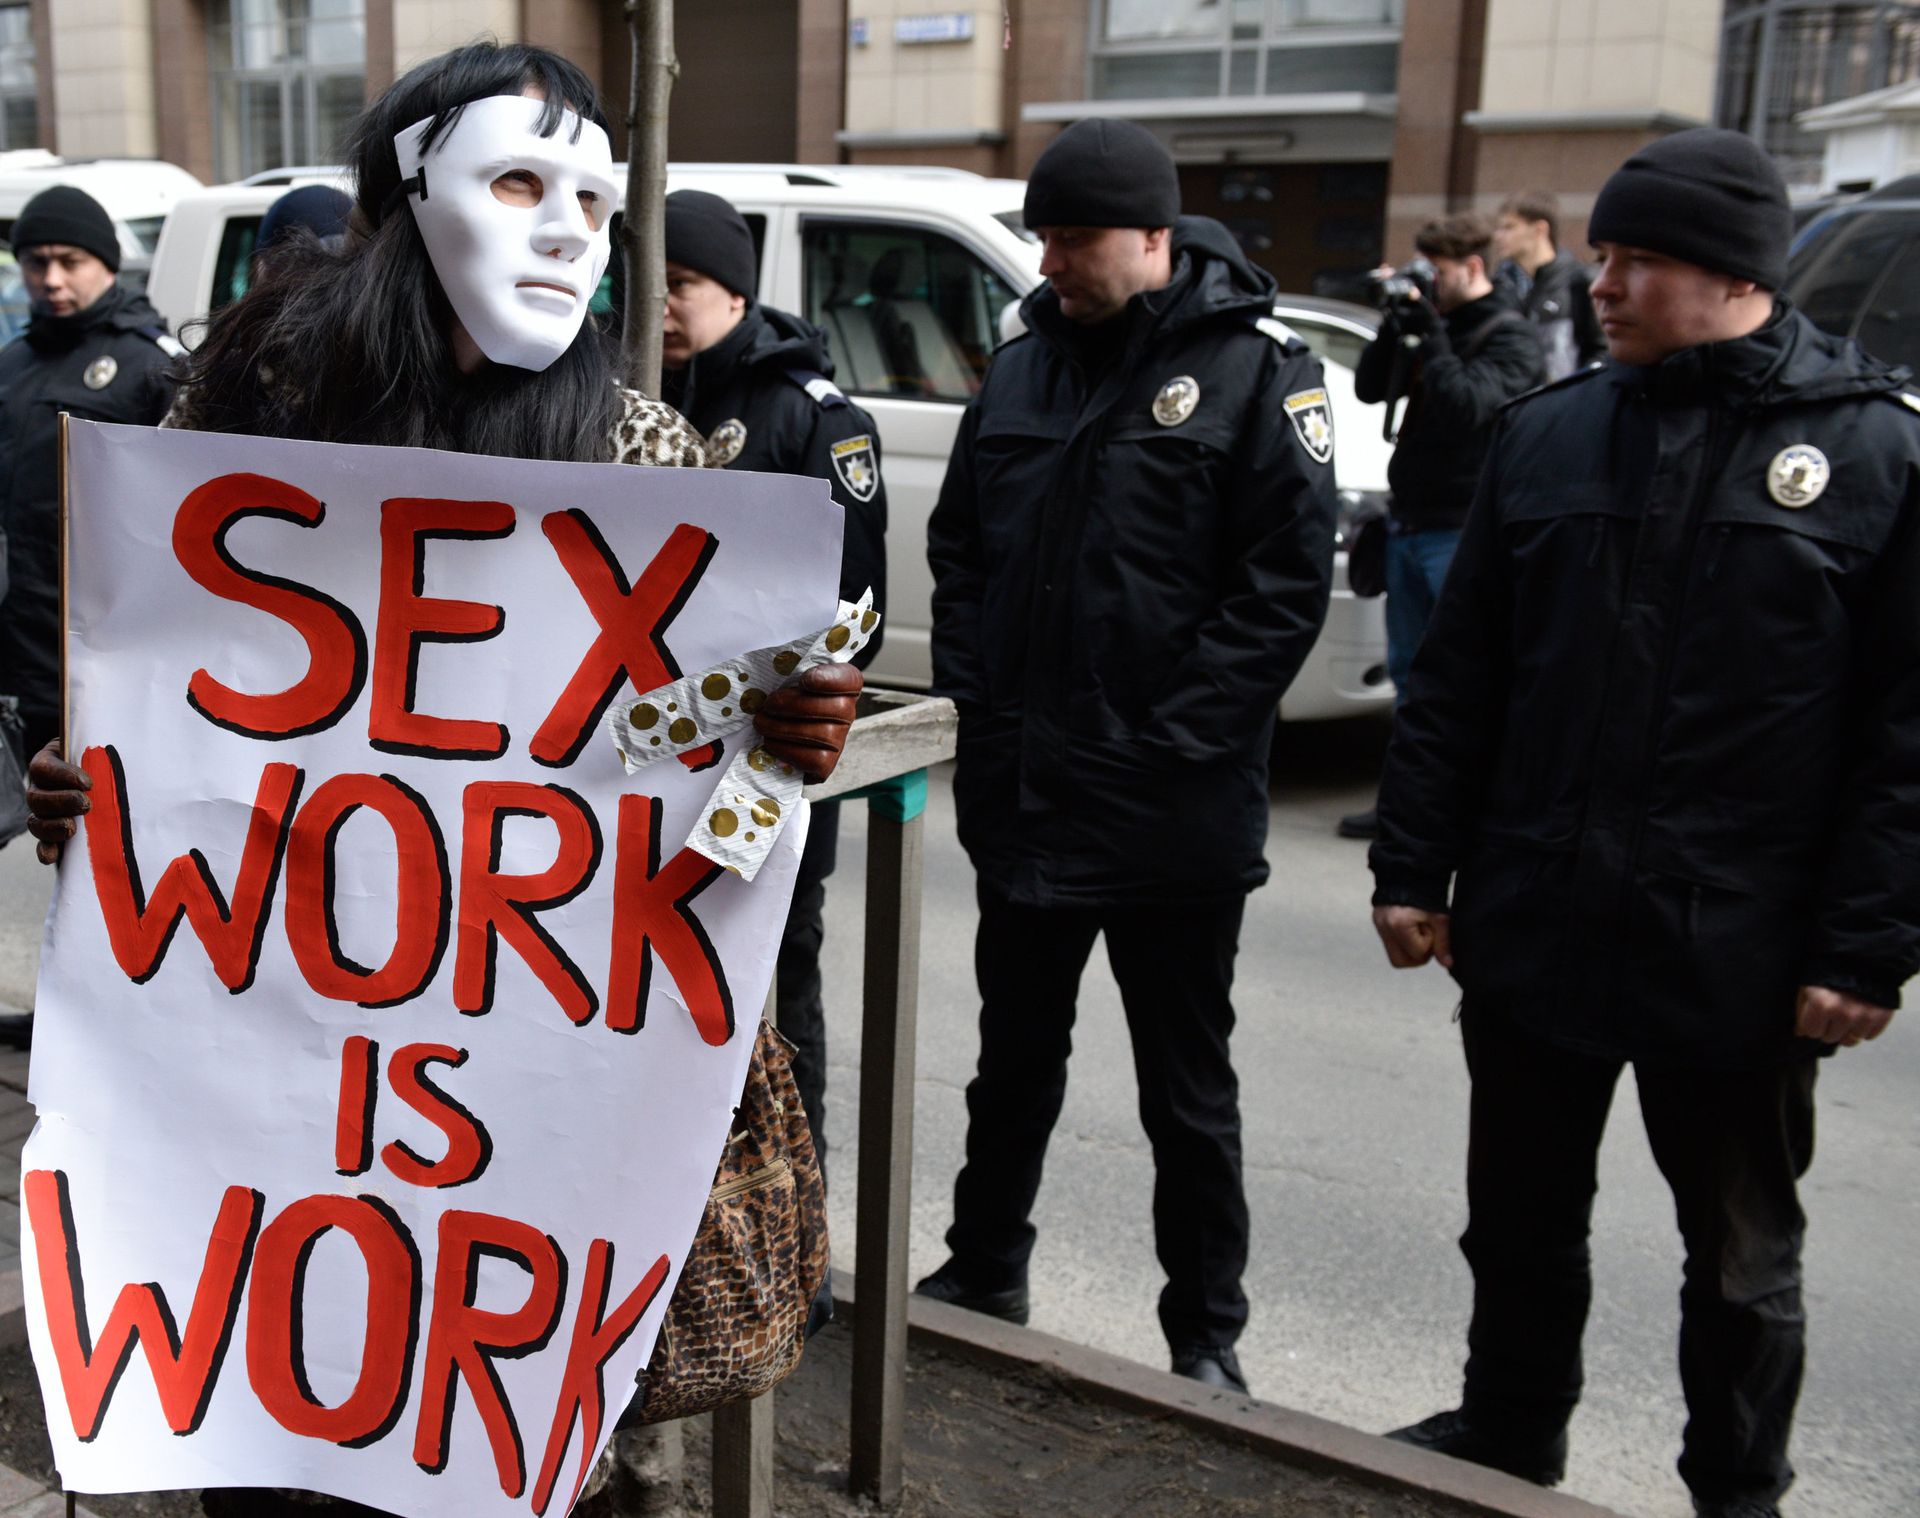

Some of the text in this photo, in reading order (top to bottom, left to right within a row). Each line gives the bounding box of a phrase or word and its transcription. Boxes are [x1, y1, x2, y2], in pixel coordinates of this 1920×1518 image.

[172, 472, 724, 773] SEX
[81, 744, 736, 1047] WORK
[335, 1035, 493, 1189] IS
[24, 1170, 670, 1518] WORK
